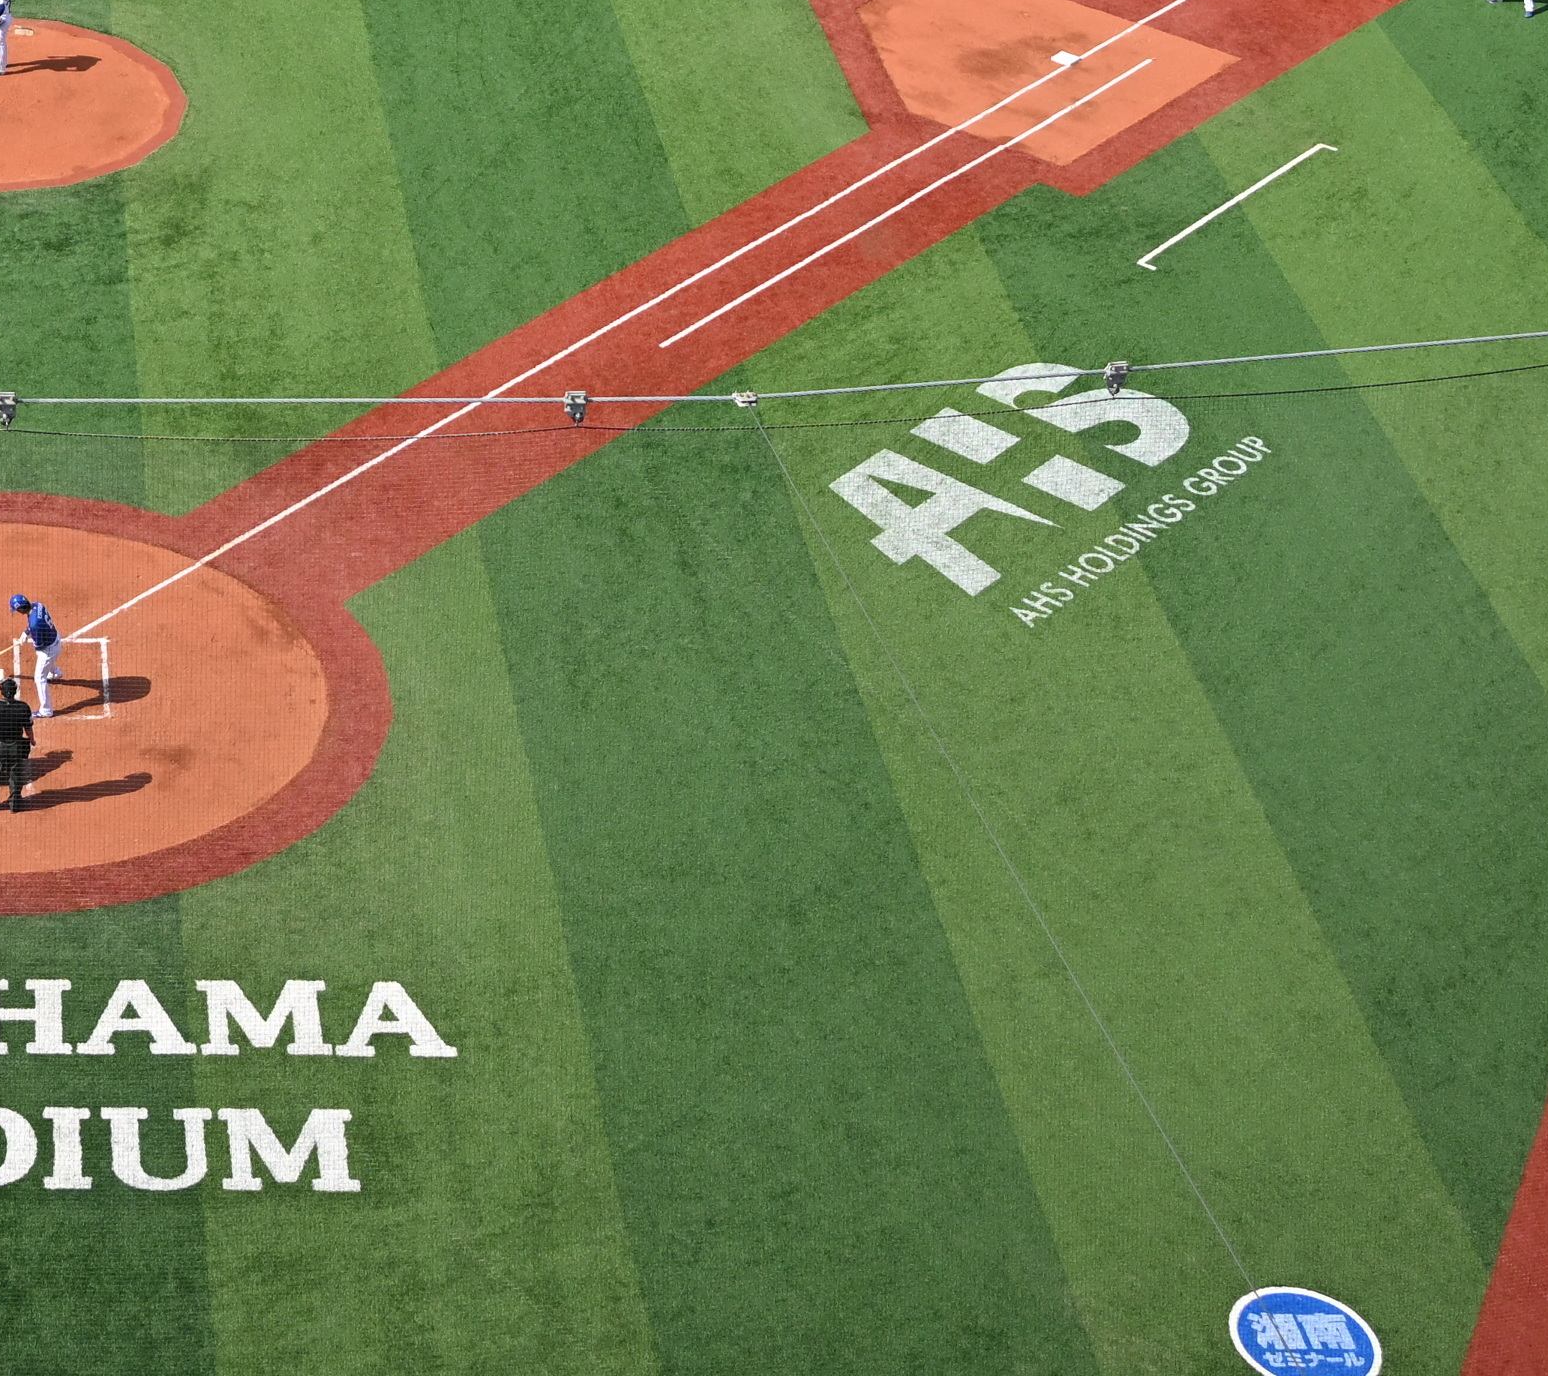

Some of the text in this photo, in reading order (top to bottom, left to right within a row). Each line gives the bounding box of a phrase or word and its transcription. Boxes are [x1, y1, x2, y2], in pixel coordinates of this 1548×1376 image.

[1008, 436, 1272, 629] AHS HOLDINGS GROUP
[1262, 1351, 1365, 1368] ゼミナール
